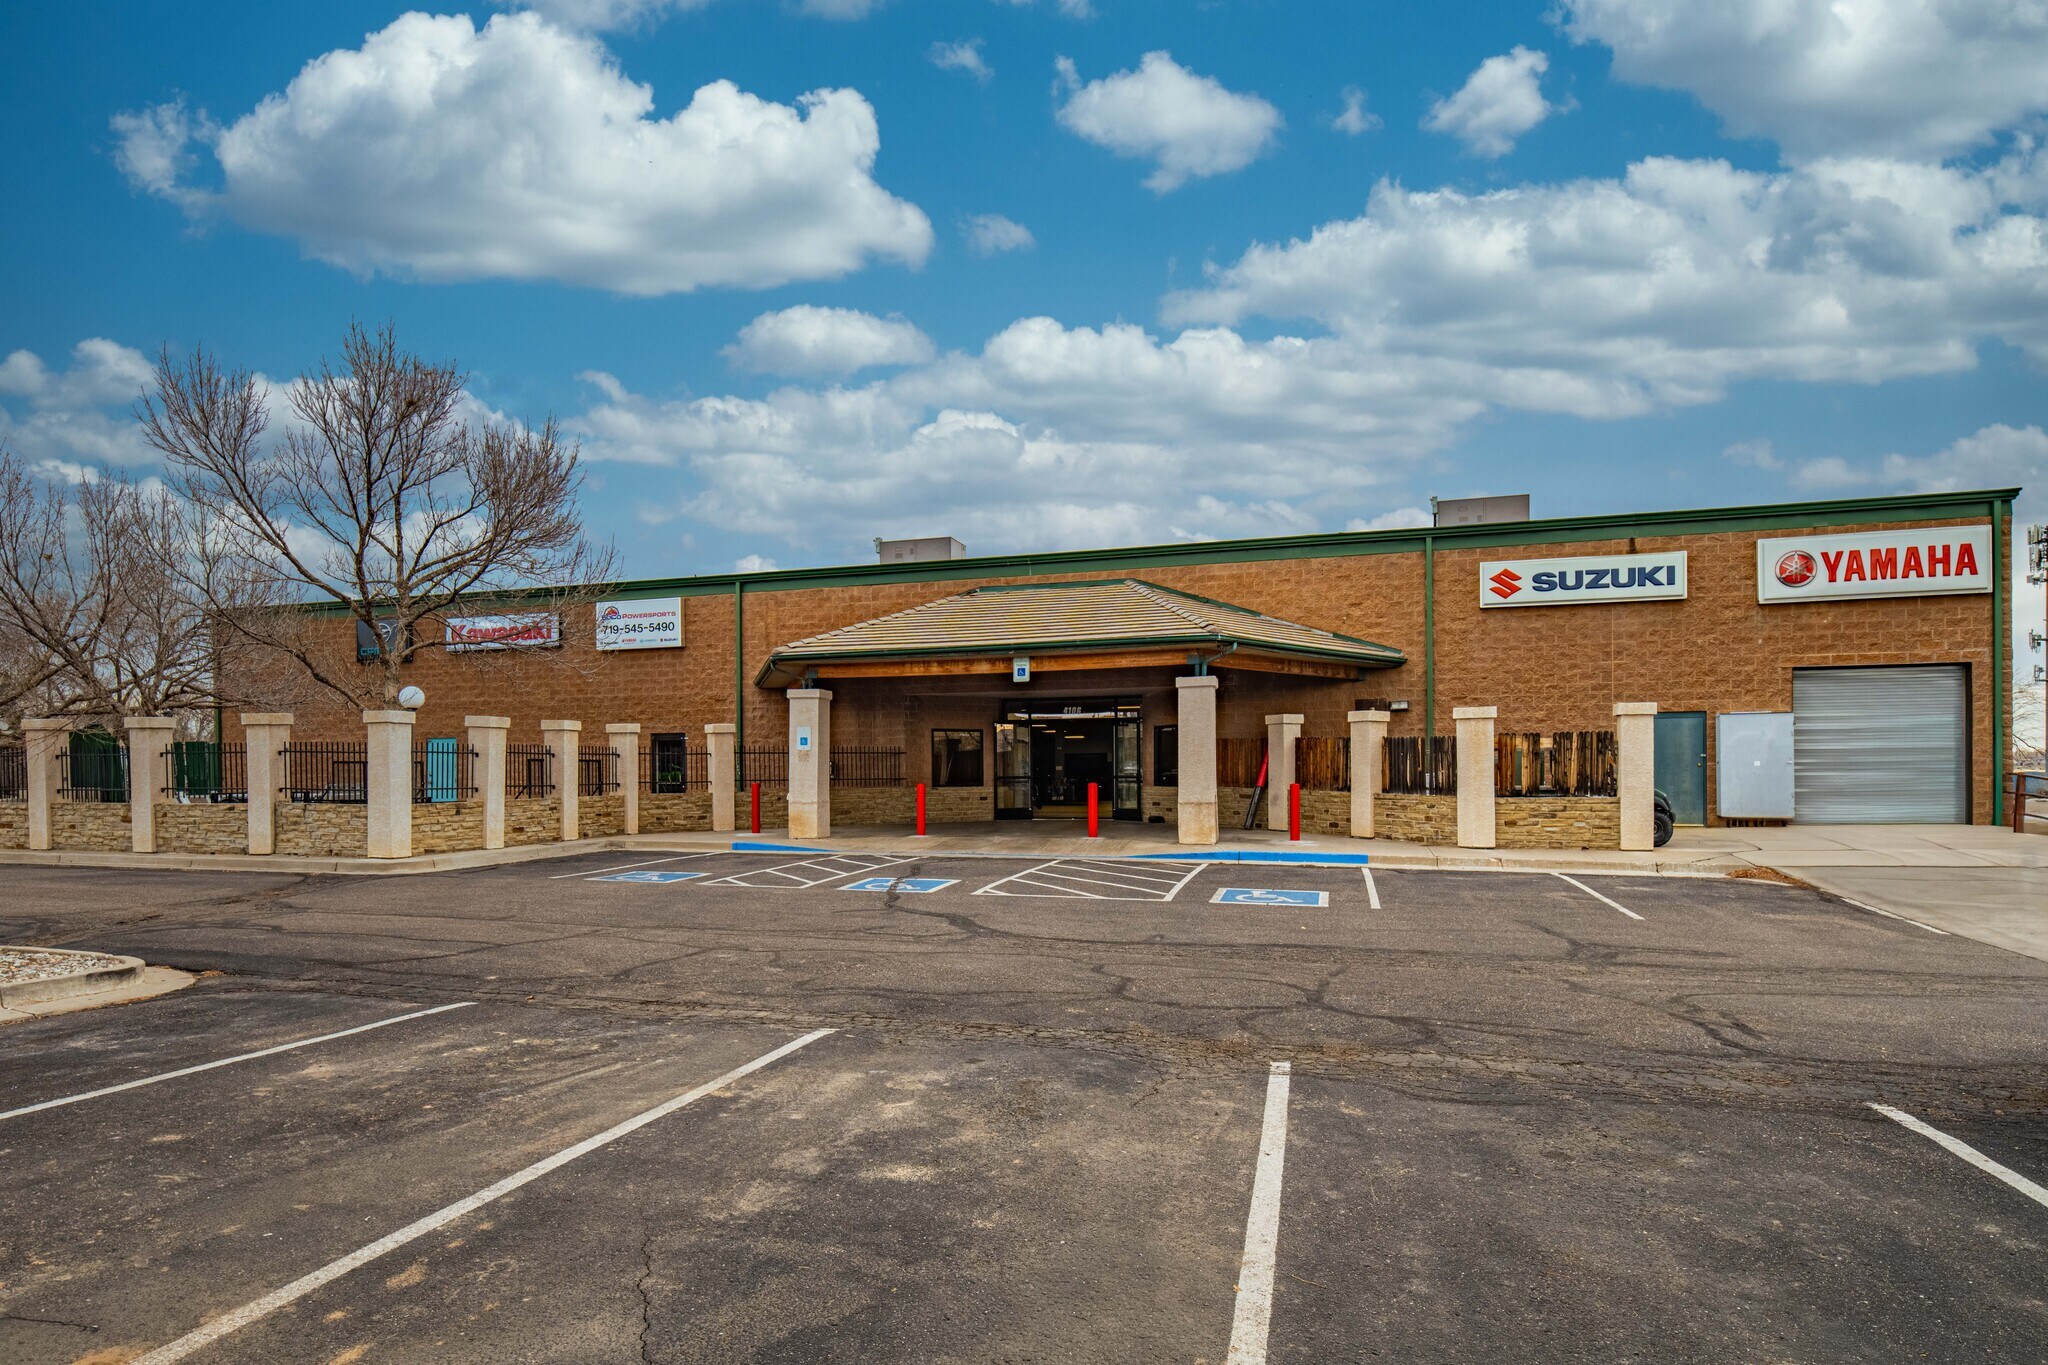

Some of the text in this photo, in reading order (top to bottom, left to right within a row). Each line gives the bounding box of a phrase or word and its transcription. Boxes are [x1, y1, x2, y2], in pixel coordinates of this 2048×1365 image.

[1820, 542, 1979, 583] YAMAHA
[1532, 564, 1676, 592] SUZUKI
[622, 611, 676, 619] POWERSPORTS
[451, 620, 552, 642] Kawasaki
[603, 622, 675, 634] 719-545-5490
[1063, 706, 1082, 714] 4106
